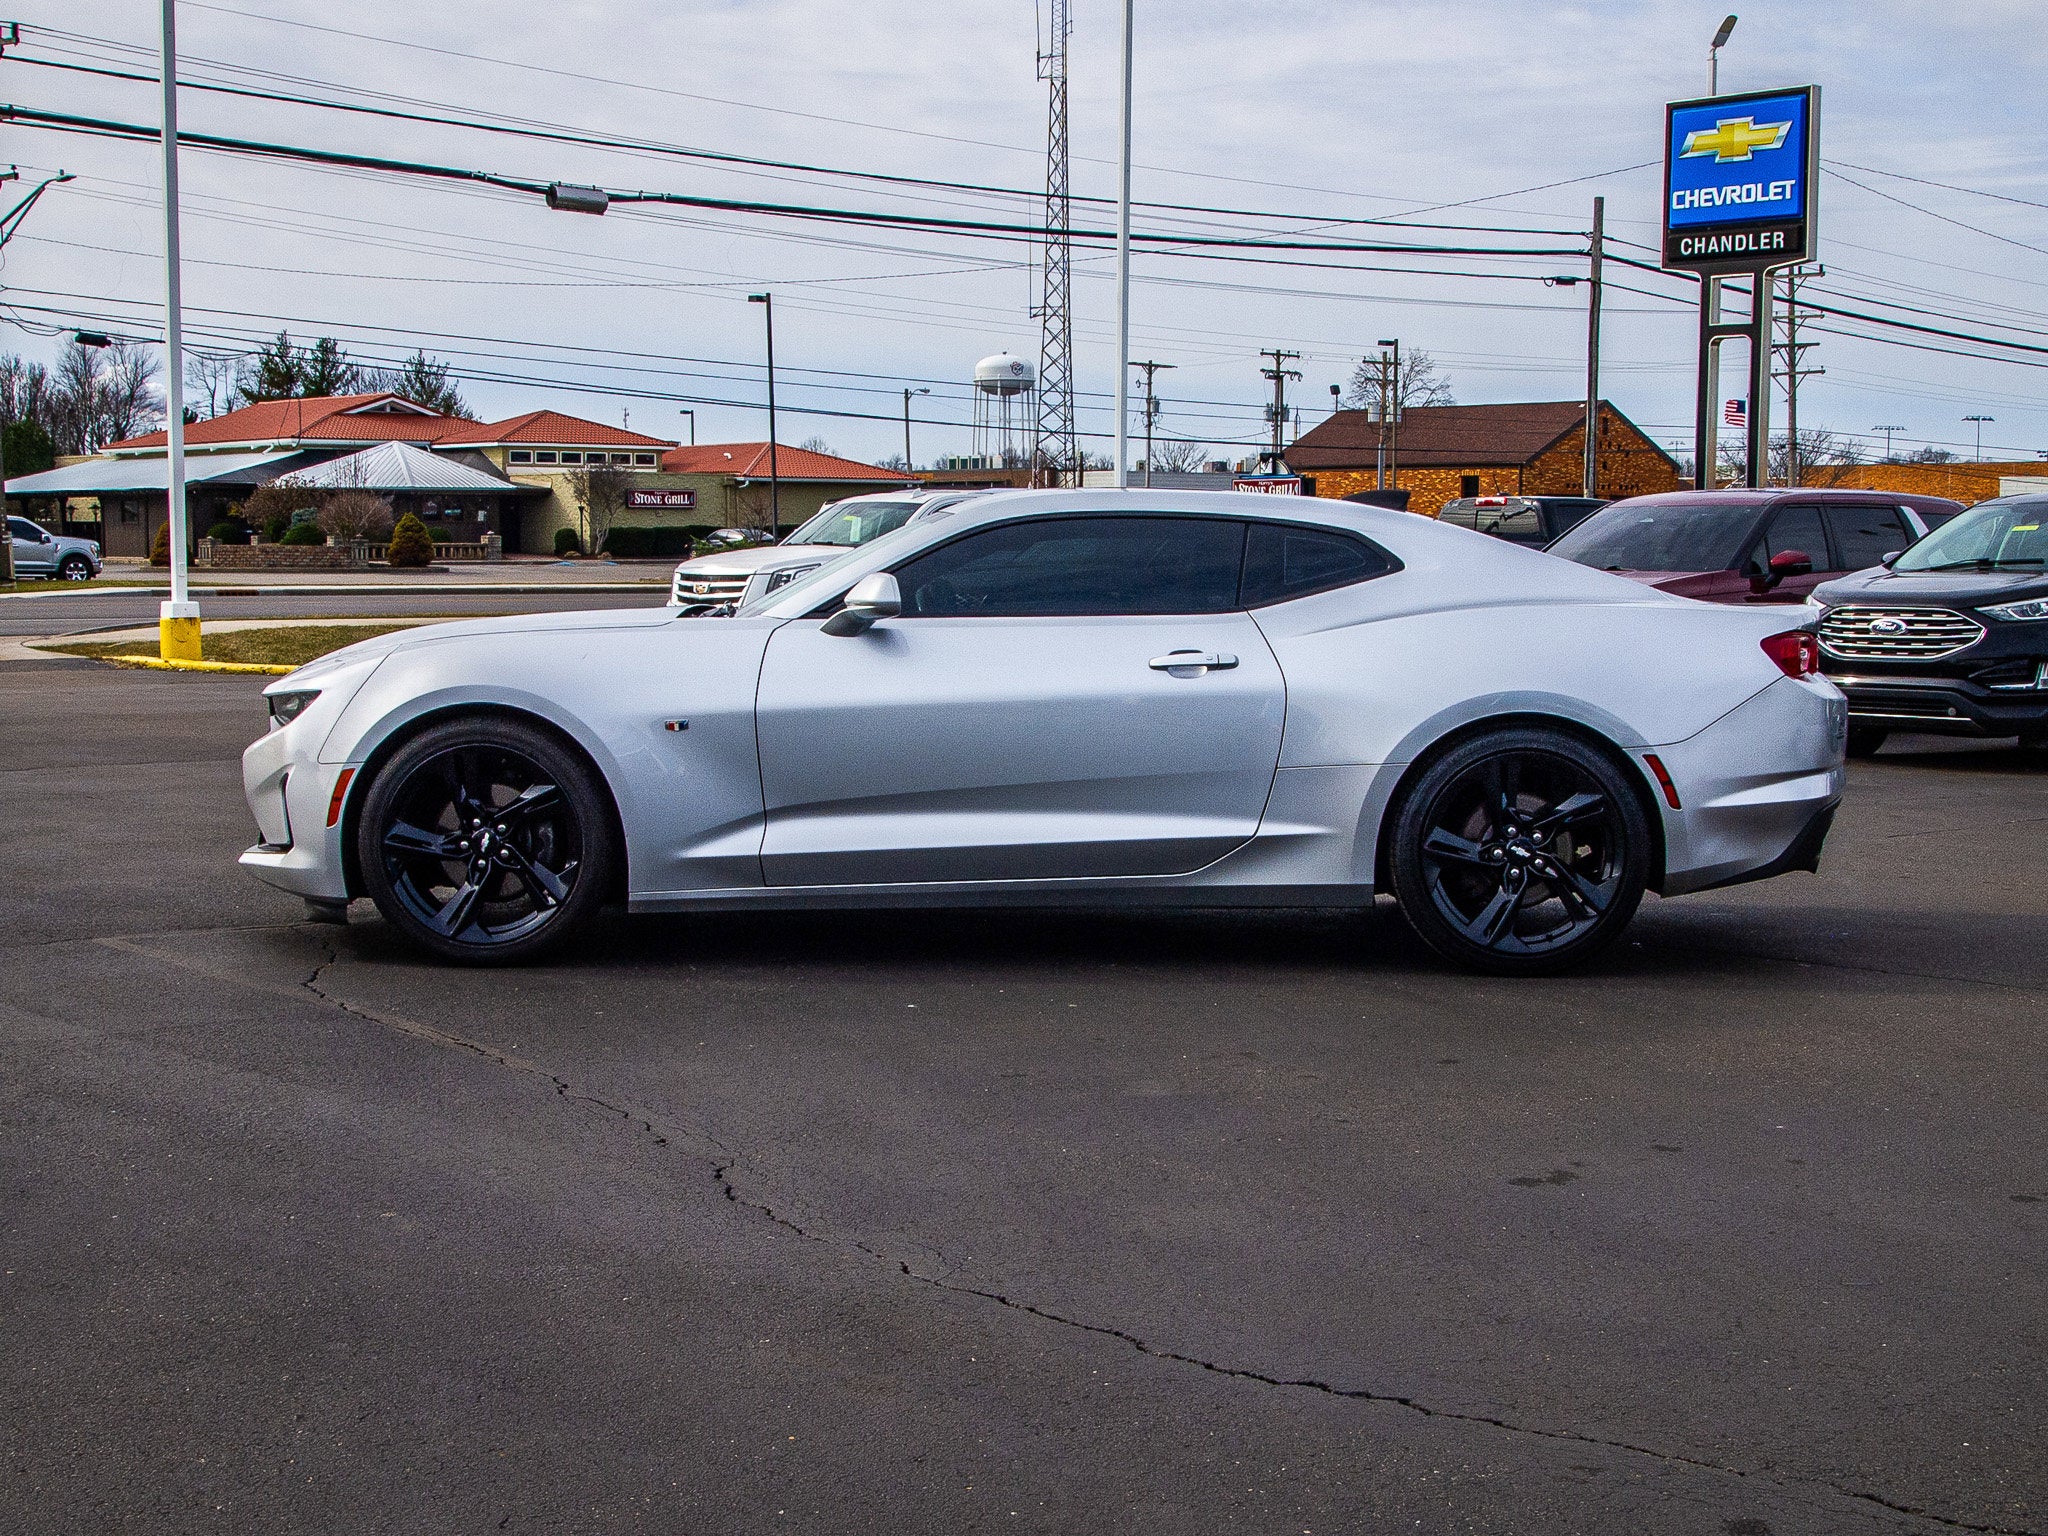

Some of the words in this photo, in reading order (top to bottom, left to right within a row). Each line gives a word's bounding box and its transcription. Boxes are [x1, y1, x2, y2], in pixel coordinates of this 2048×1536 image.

[1672, 180, 1796, 209] CHEVROLET
[1681, 232, 1784, 256] CHANDLER
[634, 492, 663, 504] STONE
[665, 494, 690, 504] GRILL
